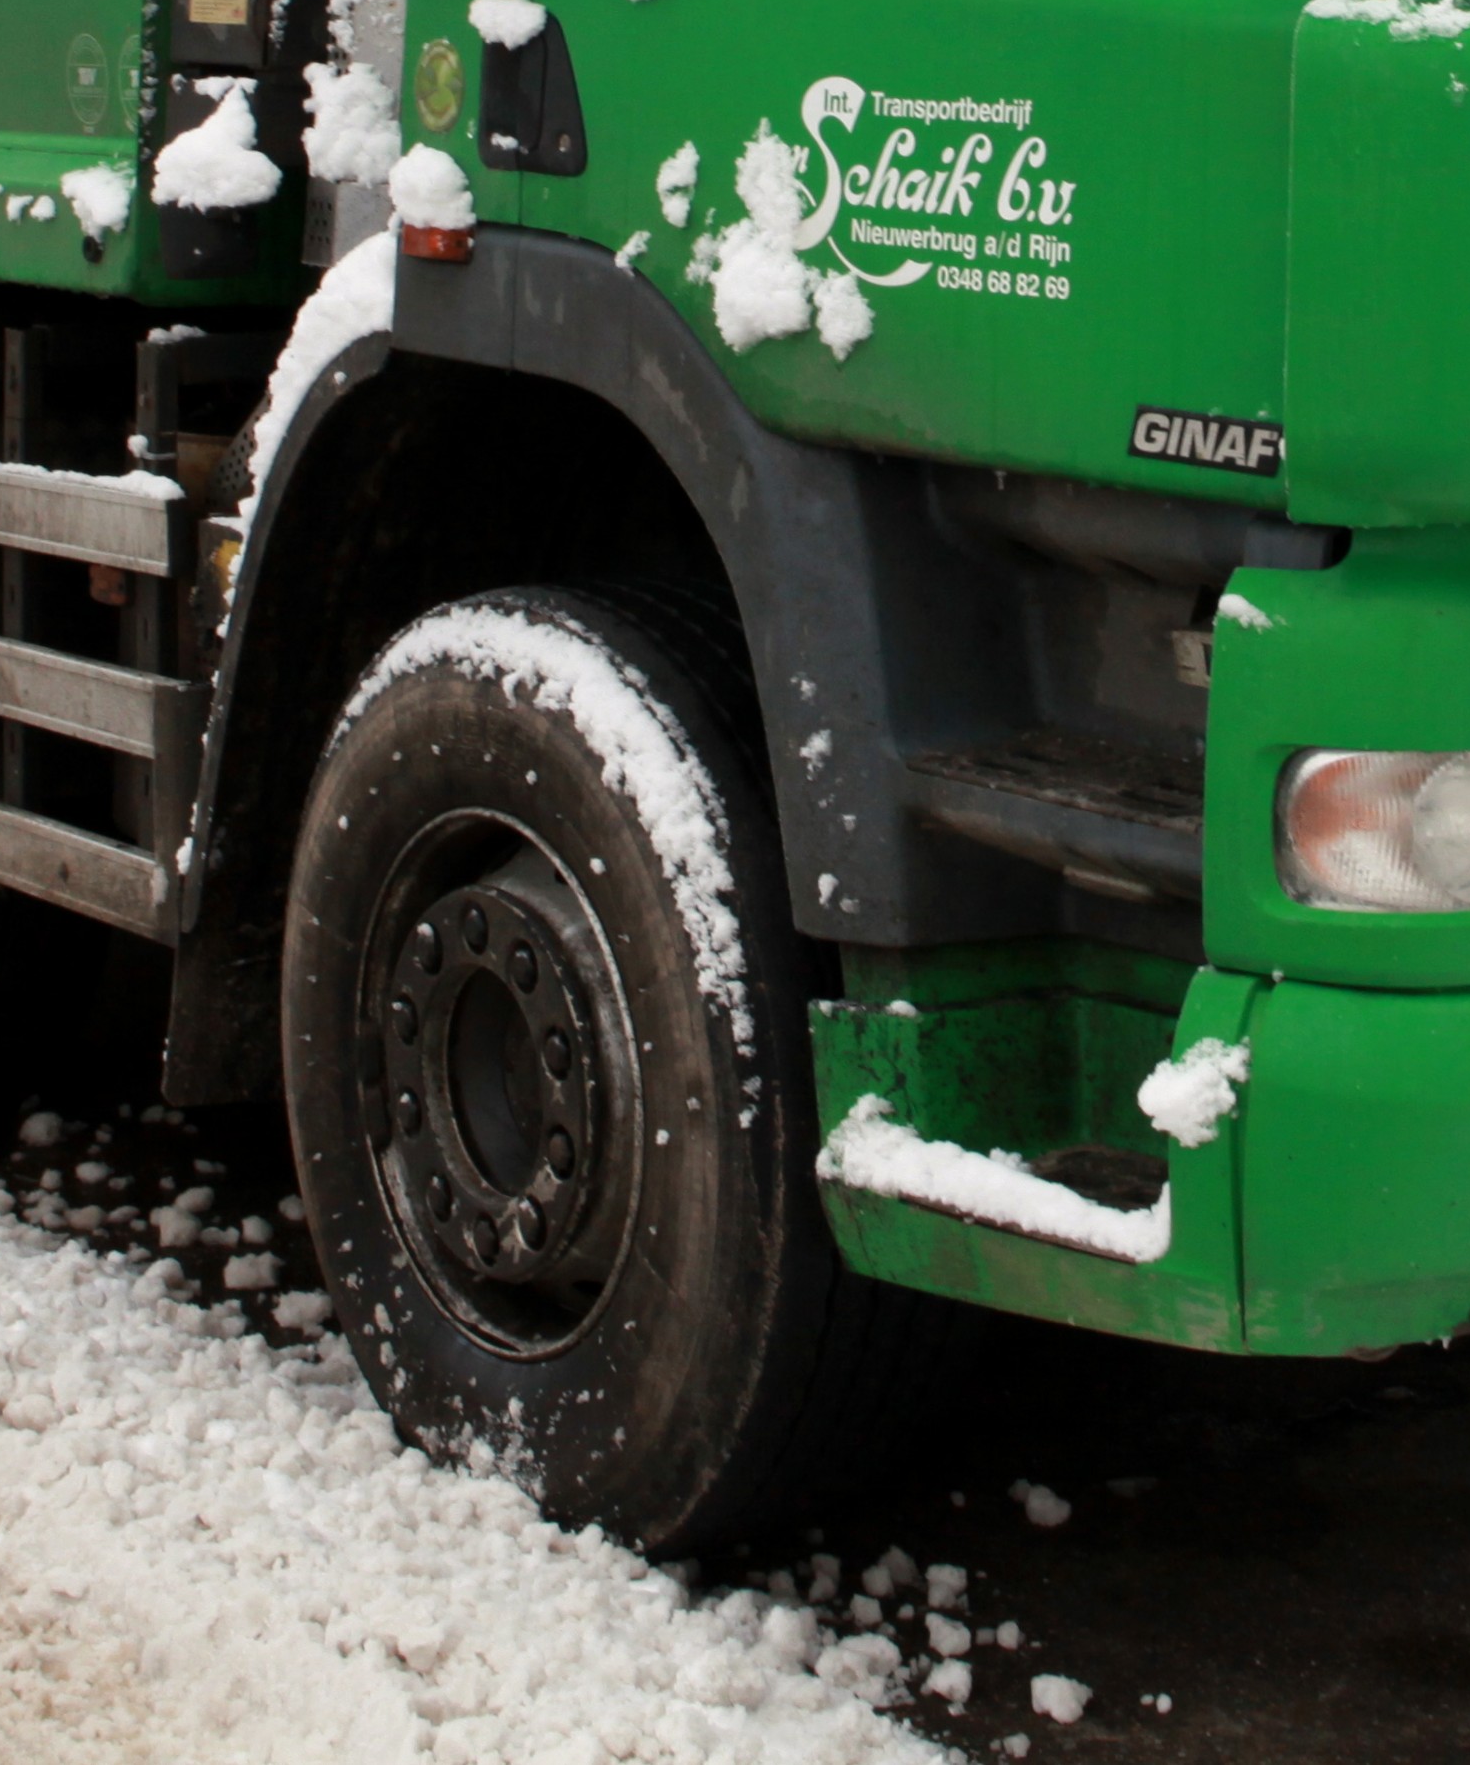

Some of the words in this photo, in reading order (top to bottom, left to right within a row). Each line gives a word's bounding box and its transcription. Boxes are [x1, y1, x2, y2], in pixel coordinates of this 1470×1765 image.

[824, 88, 853, 114] Int.
[871, 91, 1032, 131] Transportbedrijf
[794, 76, 992, 251] Schaik
[851, 218, 976, 260] Nieuwerbrug
[984, 231, 1021, 258] a/d
[1029, 233, 1071, 268] Rijn
[937, 265, 983, 292] 0348
[987, 270, 1011, 295] 68
[1016, 273, 1040, 297] 82
[1045, 276, 1070, 300] 69
[1133, 412, 1279, 469] GINAF
